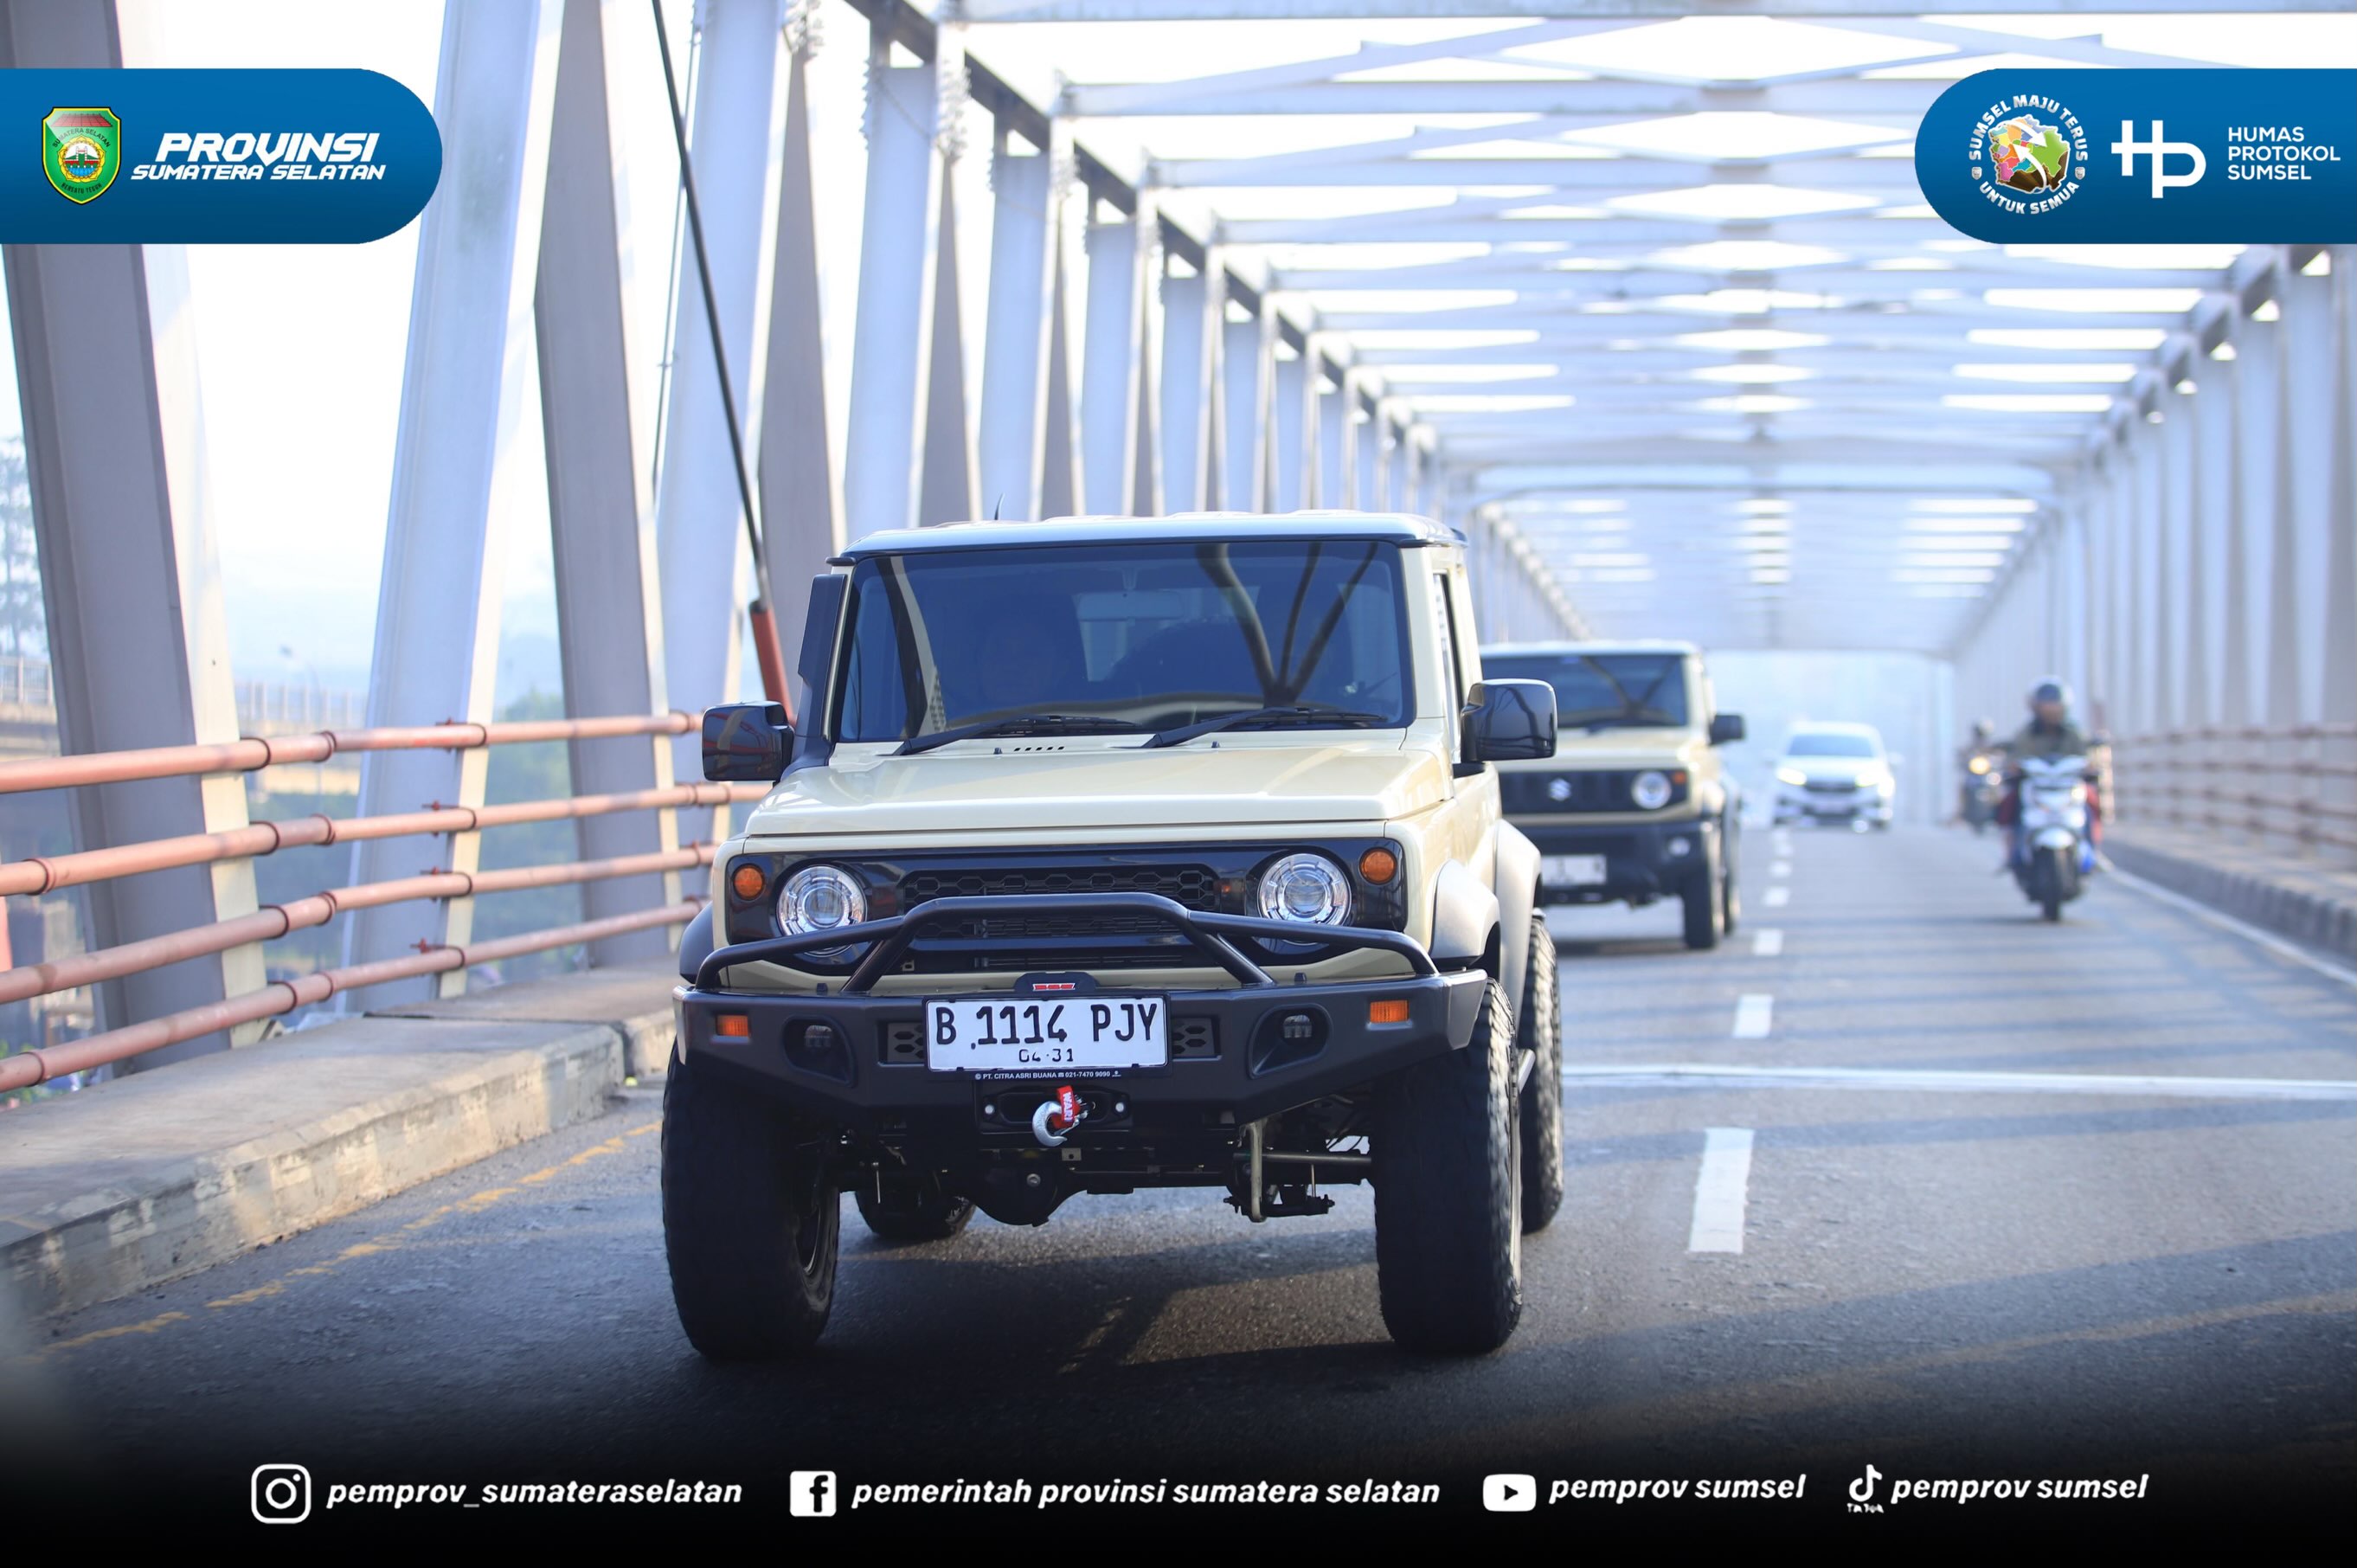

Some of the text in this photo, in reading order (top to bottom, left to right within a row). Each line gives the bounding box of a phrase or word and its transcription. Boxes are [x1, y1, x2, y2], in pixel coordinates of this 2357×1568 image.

[935, 1003, 1158, 1045] B 1114 PJY
